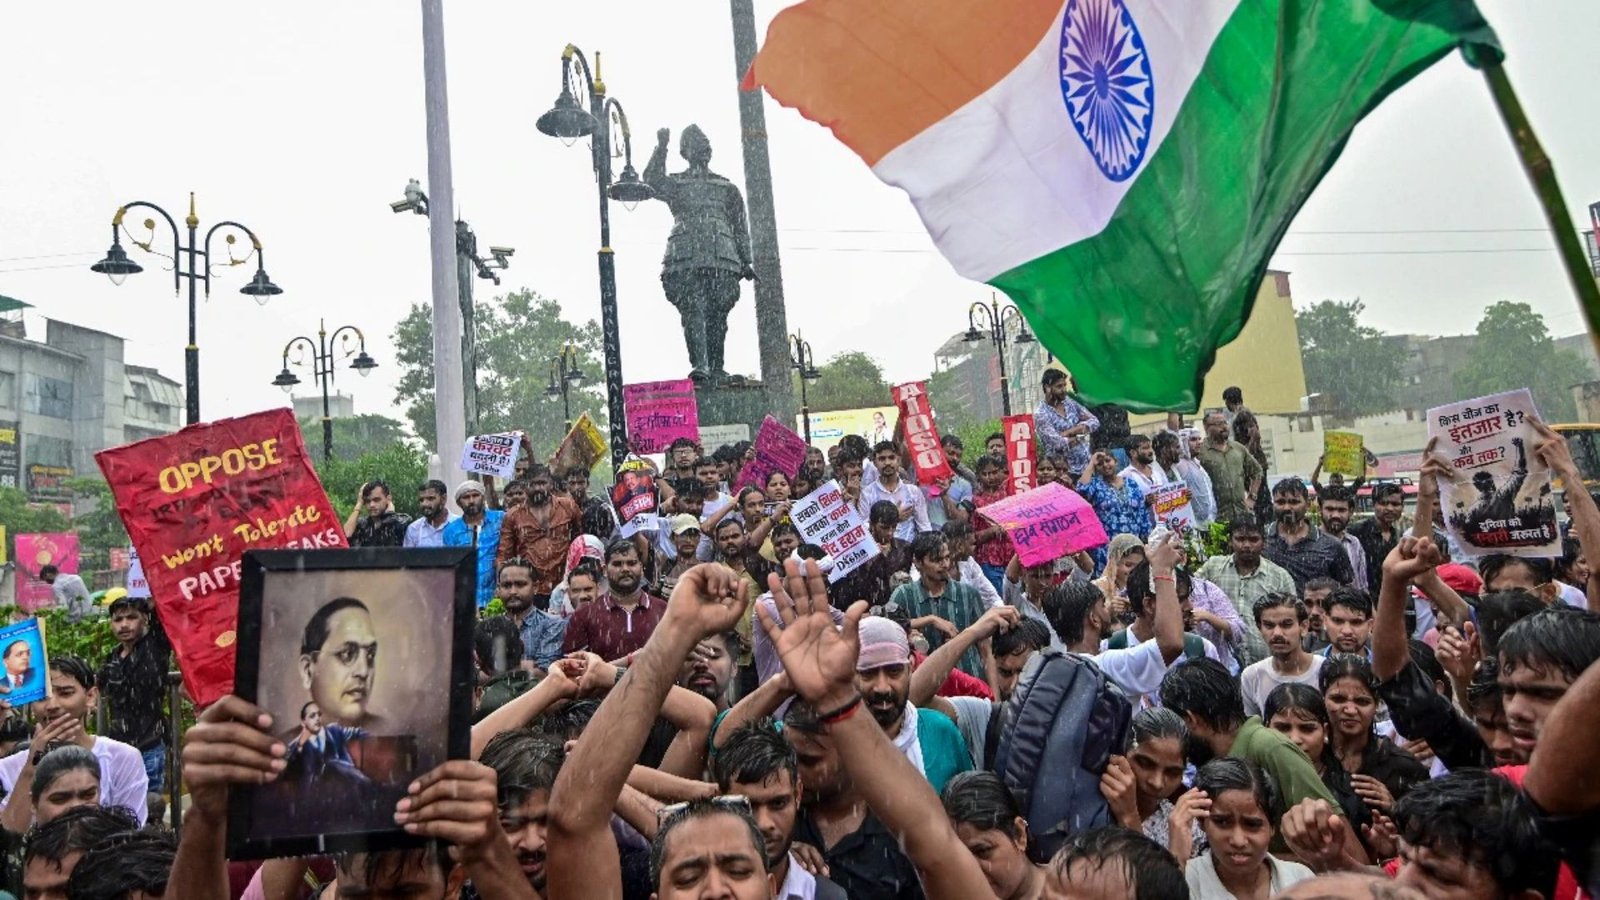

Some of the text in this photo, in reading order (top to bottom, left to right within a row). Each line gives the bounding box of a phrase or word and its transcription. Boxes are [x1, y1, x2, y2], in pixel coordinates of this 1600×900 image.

[900, 384, 943, 468] AIDSO
[1439, 413, 1460, 427] किस
[1483, 404, 1500, 414] का
[1448, 415, 1502, 444] इंतजार
[159, 438, 282, 494] OPPOSE
[473, 442, 513, 457] करवट
[1010, 422, 1032, 494] AIDS
[1459, 445, 1472, 455] और
[795, 501, 821, 523] सबको
[818, 488, 843, 508] शिक्षा
[804, 515, 830, 537] सबको
[830, 503, 851, 521] काम
[162, 534, 223, 569] Won't
[233, 505, 321, 544] Tolerate
[837, 525, 866, 549] हराम
[1478, 516, 1522, 532] दुनिया को
[179, 527, 341, 601] PAPE EAKS
